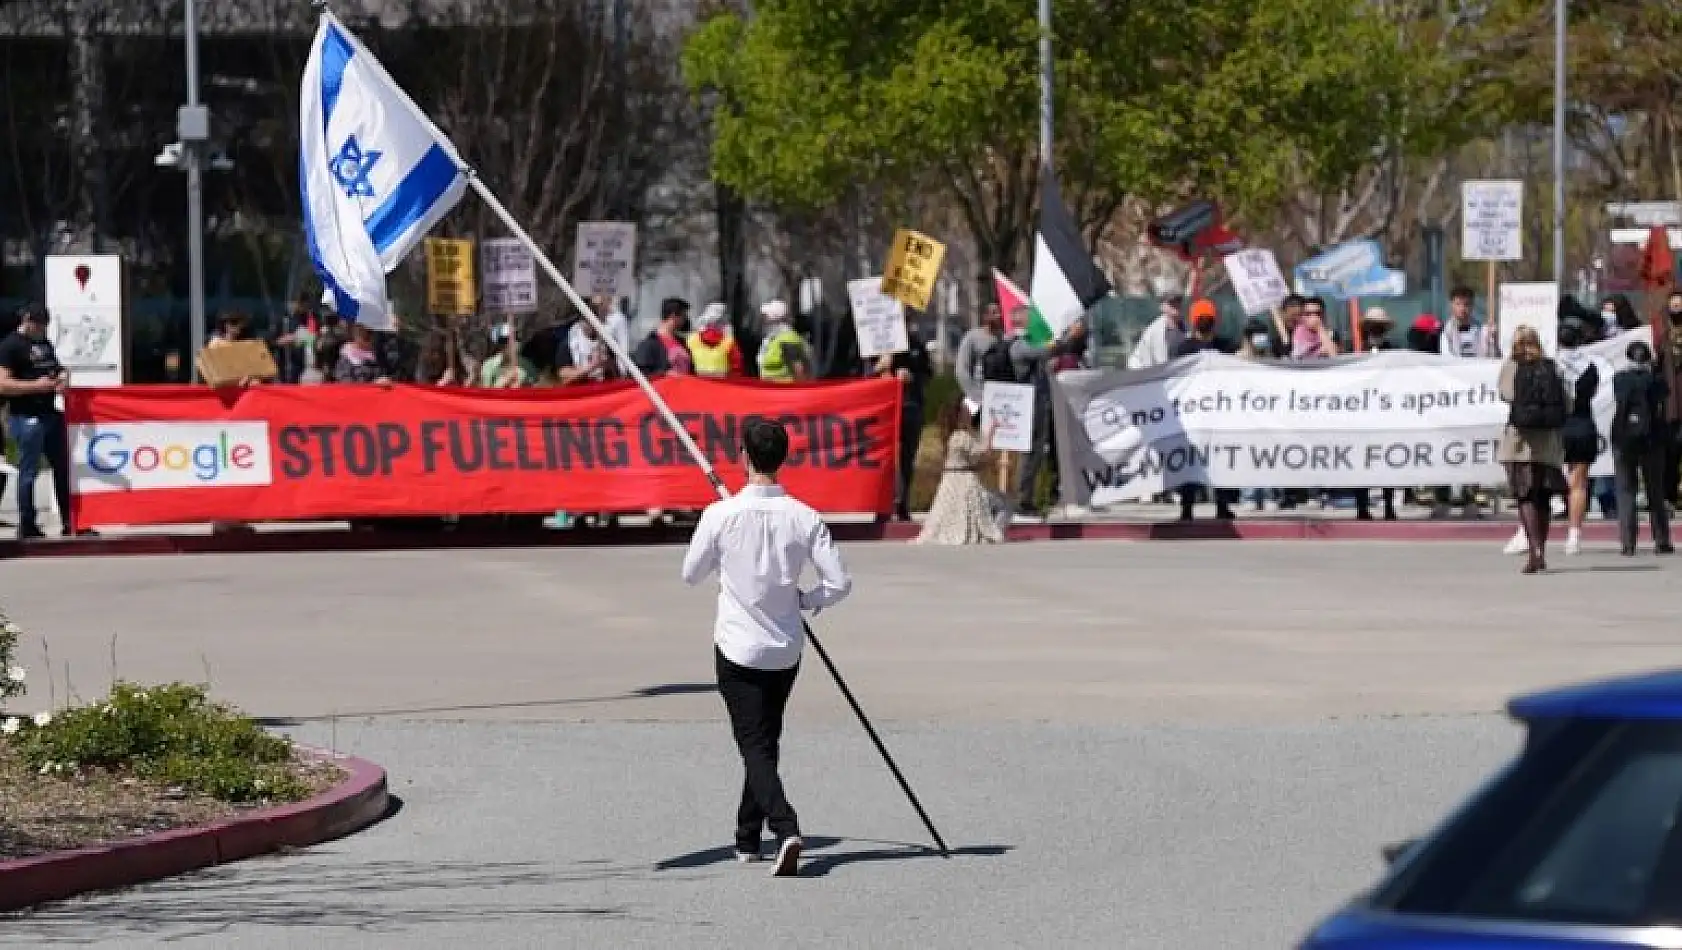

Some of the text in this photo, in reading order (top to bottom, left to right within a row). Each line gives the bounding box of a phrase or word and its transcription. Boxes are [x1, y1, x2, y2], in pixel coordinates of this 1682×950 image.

[1131, 382, 1500, 426] no tech for Israel's aparth
[87, 411, 881, 480] Google STOP FUELING GENCIDE
[1250, 442, 1354, 471] WORK
[1365, 442, 1433, 471] FOR
